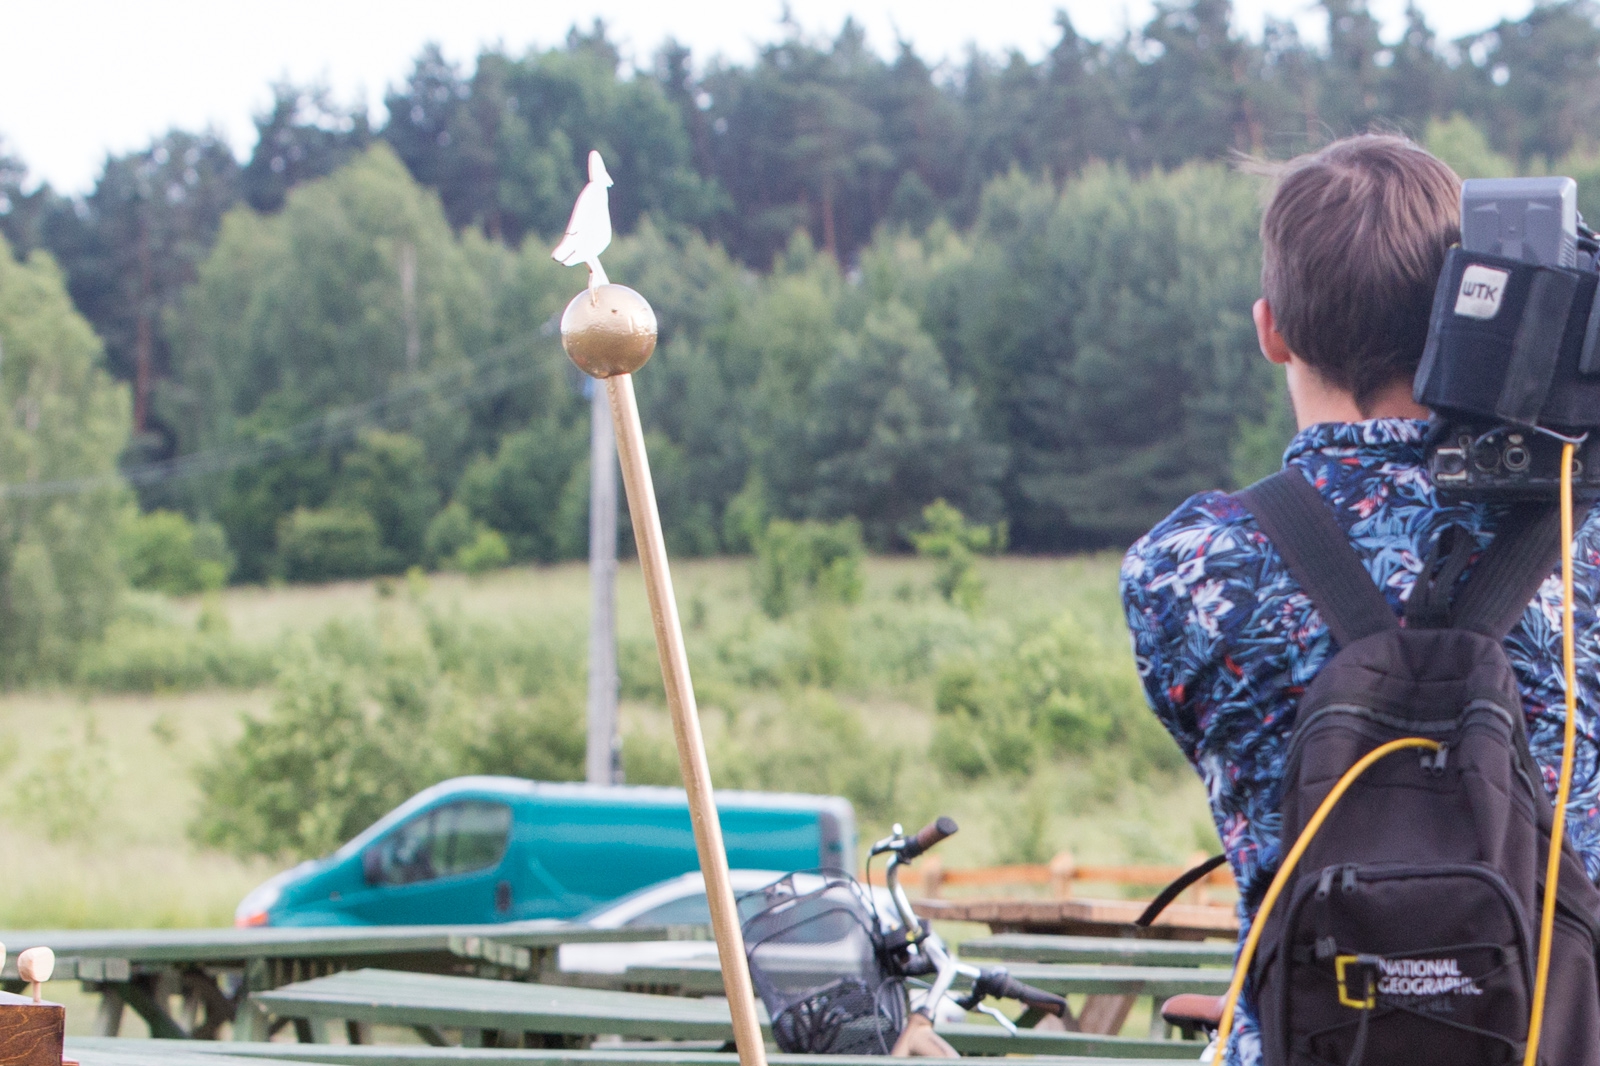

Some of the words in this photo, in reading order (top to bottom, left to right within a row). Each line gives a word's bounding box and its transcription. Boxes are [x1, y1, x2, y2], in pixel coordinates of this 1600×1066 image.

[1463, 281, 1498, 302] WTK
[1378, 958, 1462, 977] NATIONAL
[1377, 976, 1483, 996] GEOGRAPHIC
